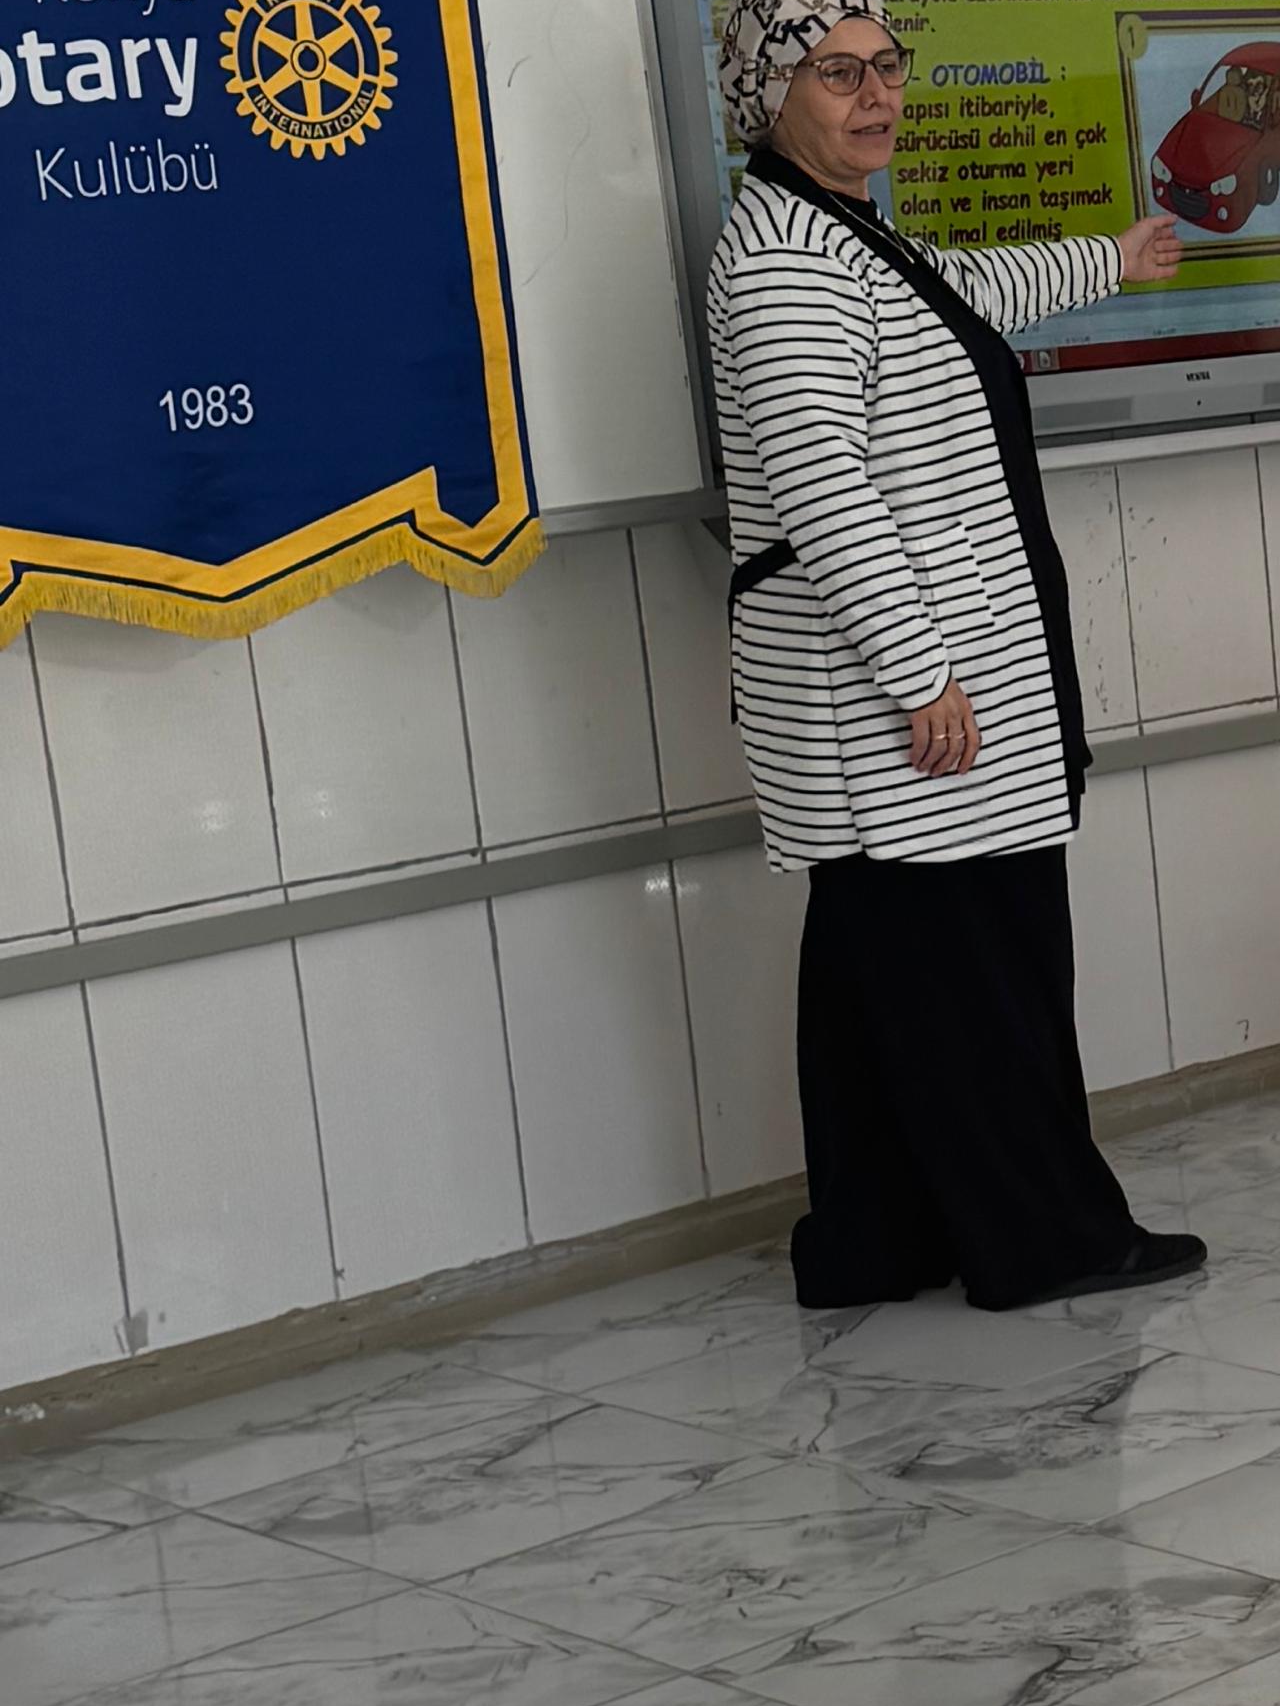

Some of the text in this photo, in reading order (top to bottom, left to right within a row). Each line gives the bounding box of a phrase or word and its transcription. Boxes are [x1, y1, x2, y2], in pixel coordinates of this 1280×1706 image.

[931, 56, 1051, 88] OTOMOBİL
[253, 88, 376, 139] INTERNATIONAL
[959, 93, 1055, 121] itibariyle,
[895, 122, 1107, 153] sürücüsü dahil en çok
[35, 138, 218, 201] Kulübü
[896, 154, 1074, 184] sekiz oturma yeri
[900, 183, 1113, 216] olan ve insan taşımak
[948, 221, 987, 244] imal
[159, 382, 255, 434] 1983
